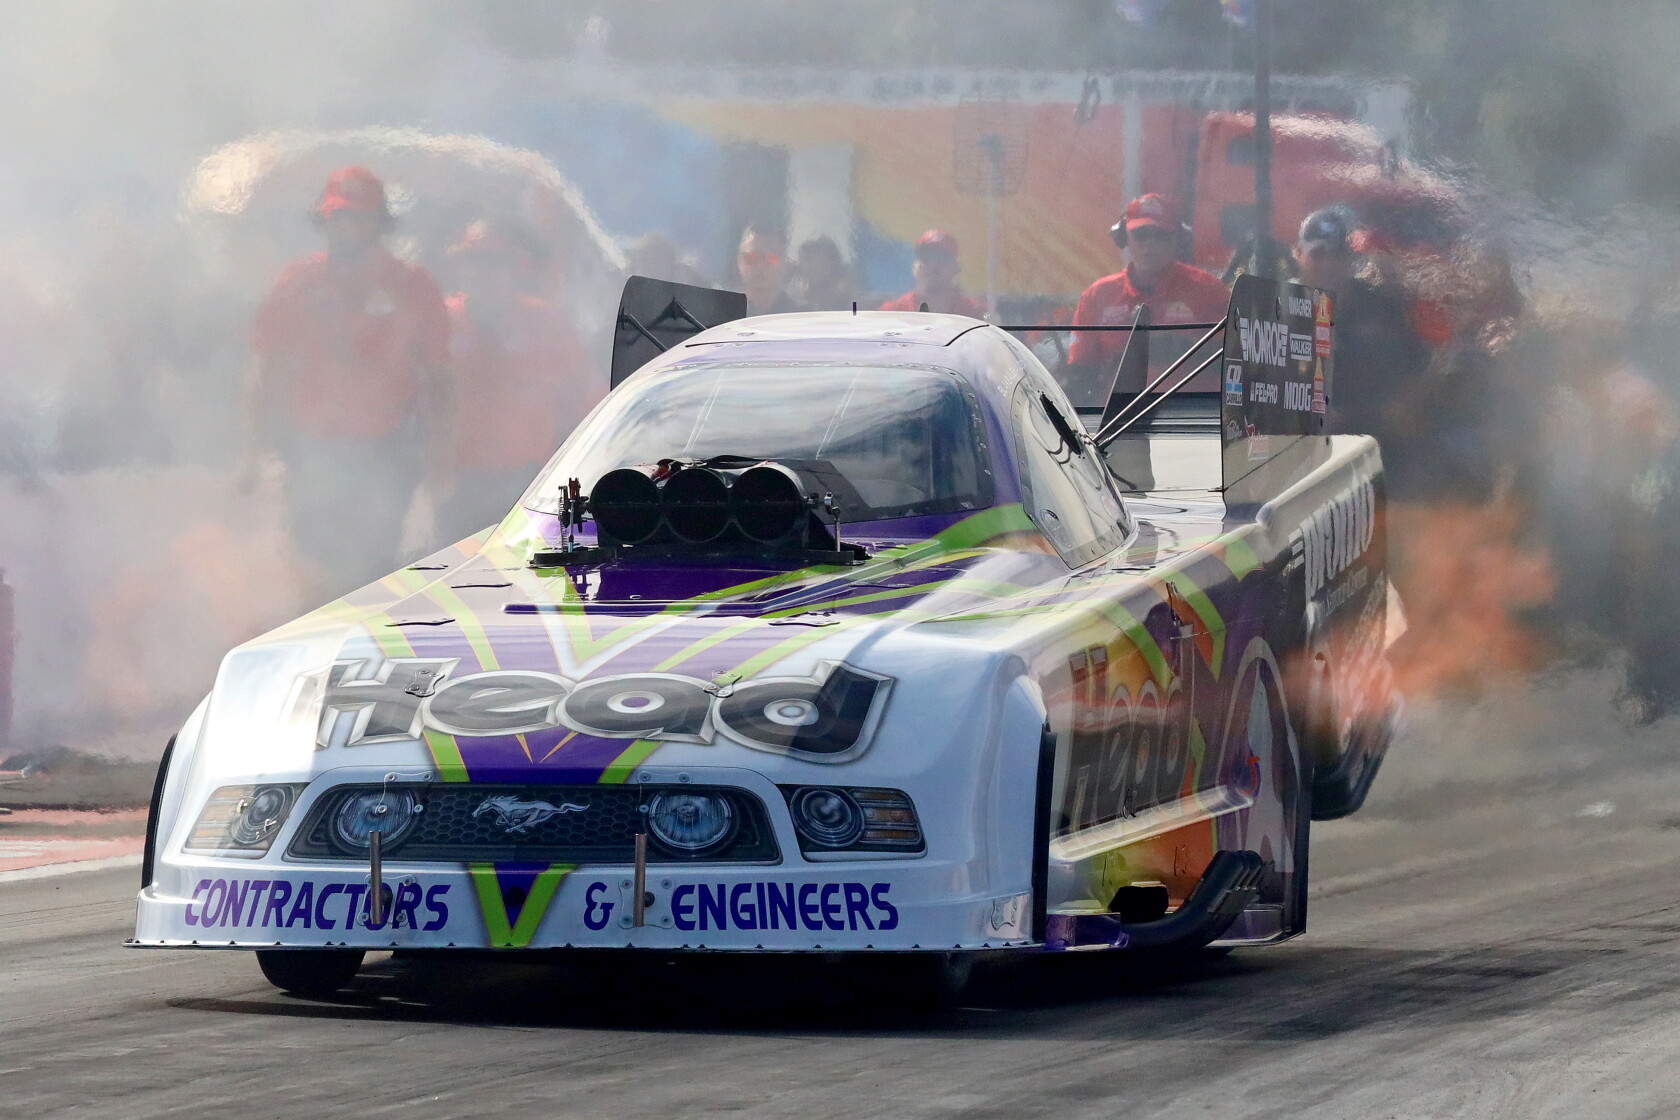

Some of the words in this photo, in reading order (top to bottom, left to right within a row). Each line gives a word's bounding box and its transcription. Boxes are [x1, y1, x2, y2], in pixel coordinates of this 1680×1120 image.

[1288, 296, 1312, 318] WAGNER
[1240, 318, 1288, 367] MONROE
[1290, 337, 1312, 357] WALKER
[1284, 381, 1312, 411] MOOG
[184, 878, 452, 931] CONTRACTORS
[583, 881, 615, 931] &
[671, 882, 899, 931] ENGINEERS
